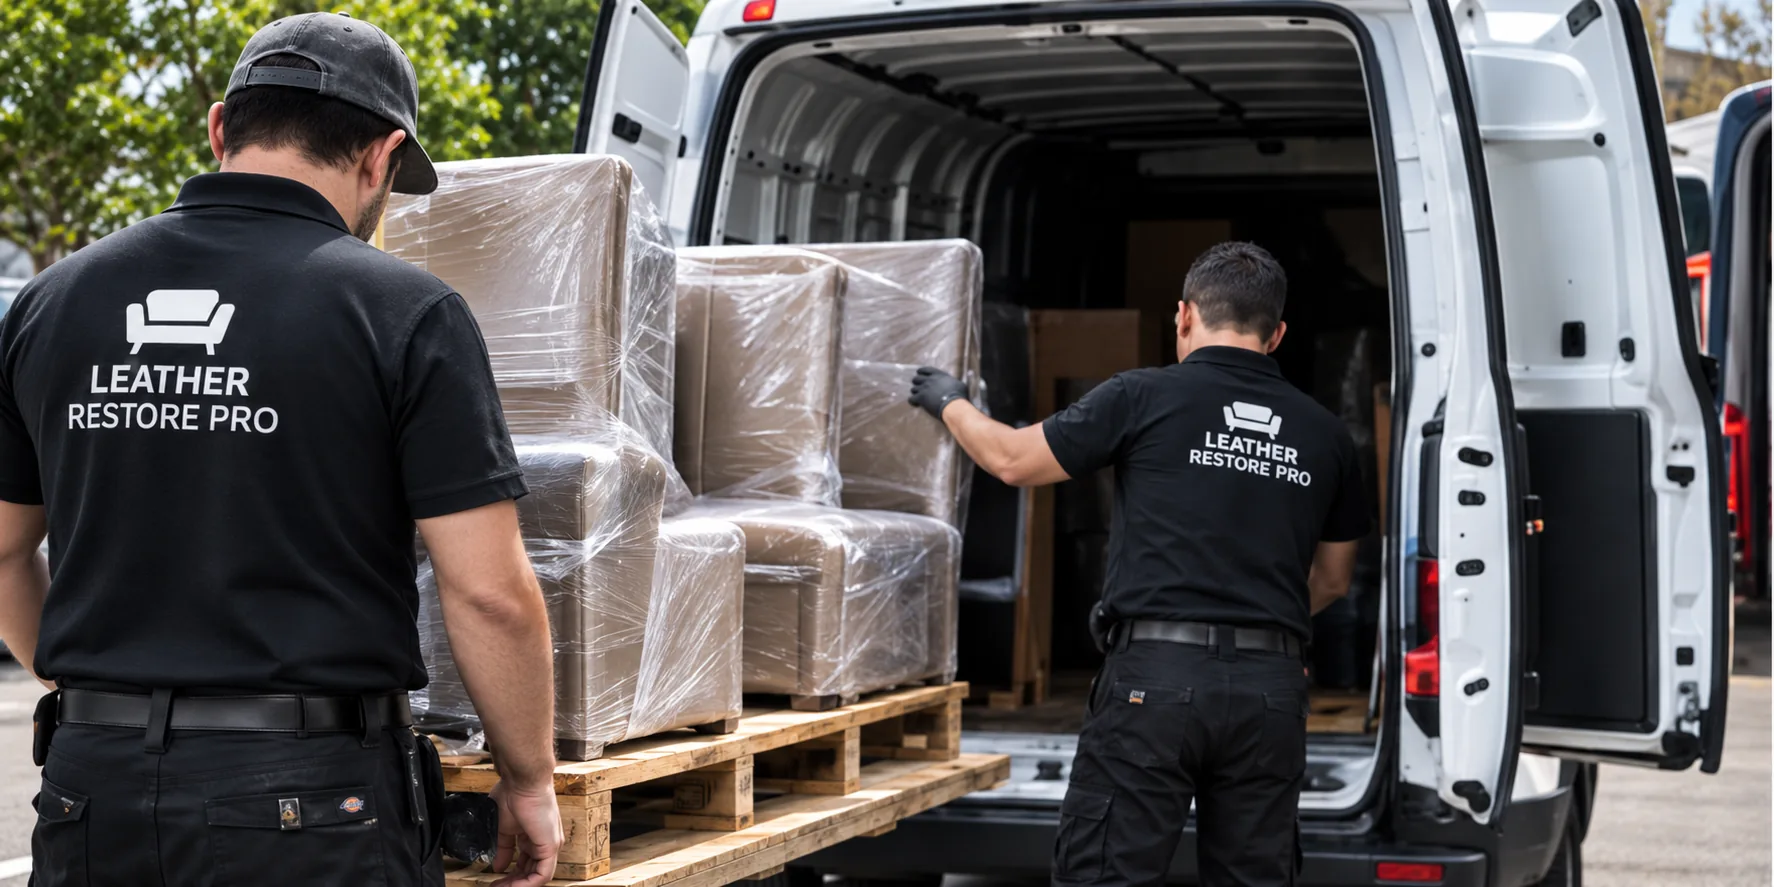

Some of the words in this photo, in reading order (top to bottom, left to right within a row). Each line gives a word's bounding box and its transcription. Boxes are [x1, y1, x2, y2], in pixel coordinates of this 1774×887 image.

[91, 364, 250, 396] LEATHER
[68, 402, 200, 430] RESTORE
[209, 404, 279, 434] PRO
[1205, 431, 1298, 465] LEATHER
[1189, 449, 1271, 477] RESTORE
[1275, 464, 1312, 487] PRO
